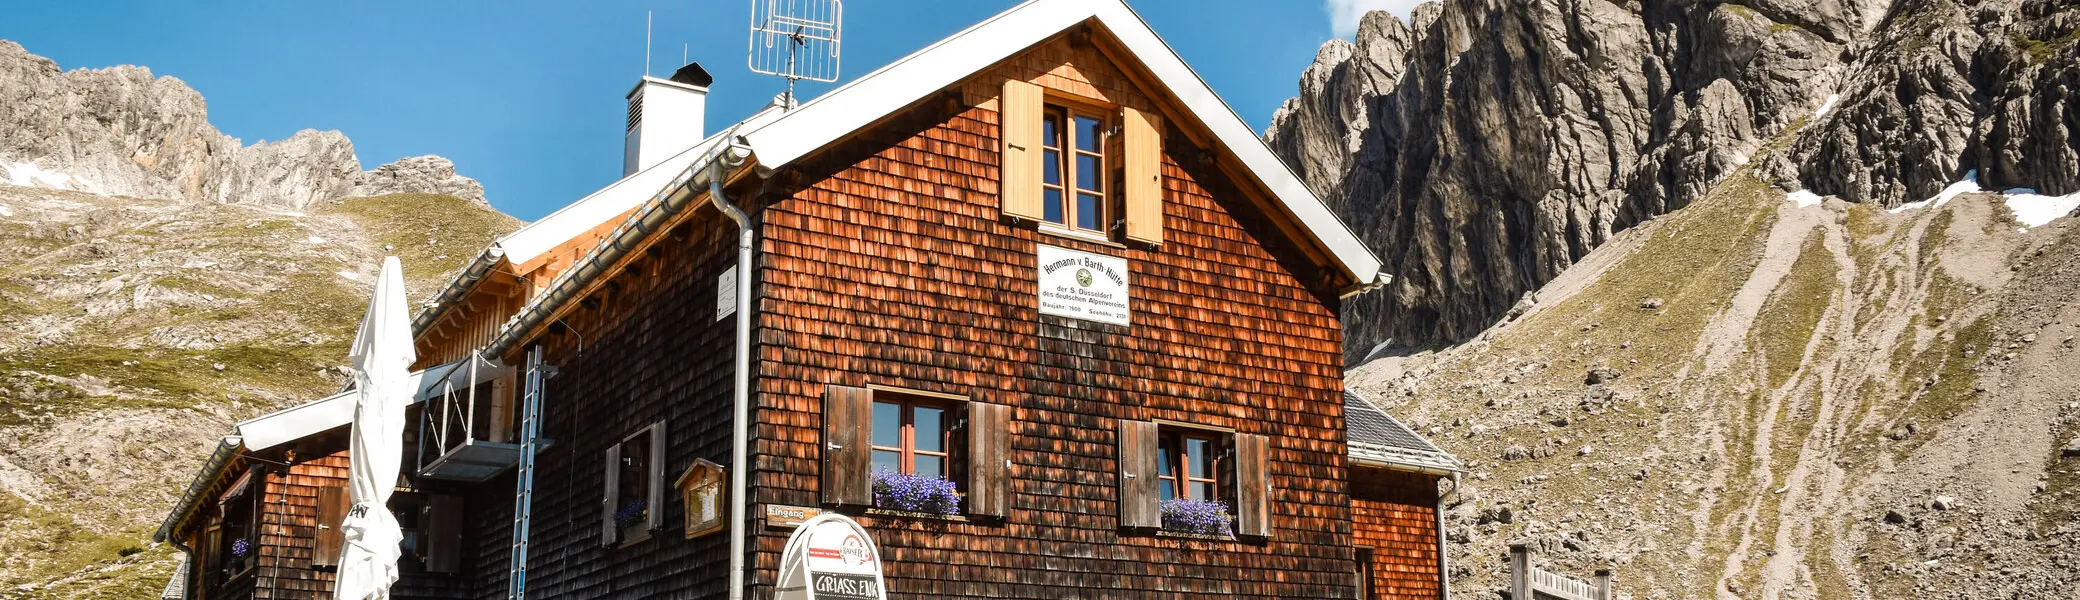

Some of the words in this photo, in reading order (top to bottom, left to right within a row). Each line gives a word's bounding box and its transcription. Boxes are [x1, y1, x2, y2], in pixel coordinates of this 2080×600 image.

[1043, 258, 1076, 275] Hermann
[1042, 290, 1054, 298] des
[1055, 292, 1087, 303] deutschen
[1088, 298, 1126, 309] Alpenvereins
[1078, 288, 1113, 299] Düsseldorf
[768, 506, 804, 519] Eingang
